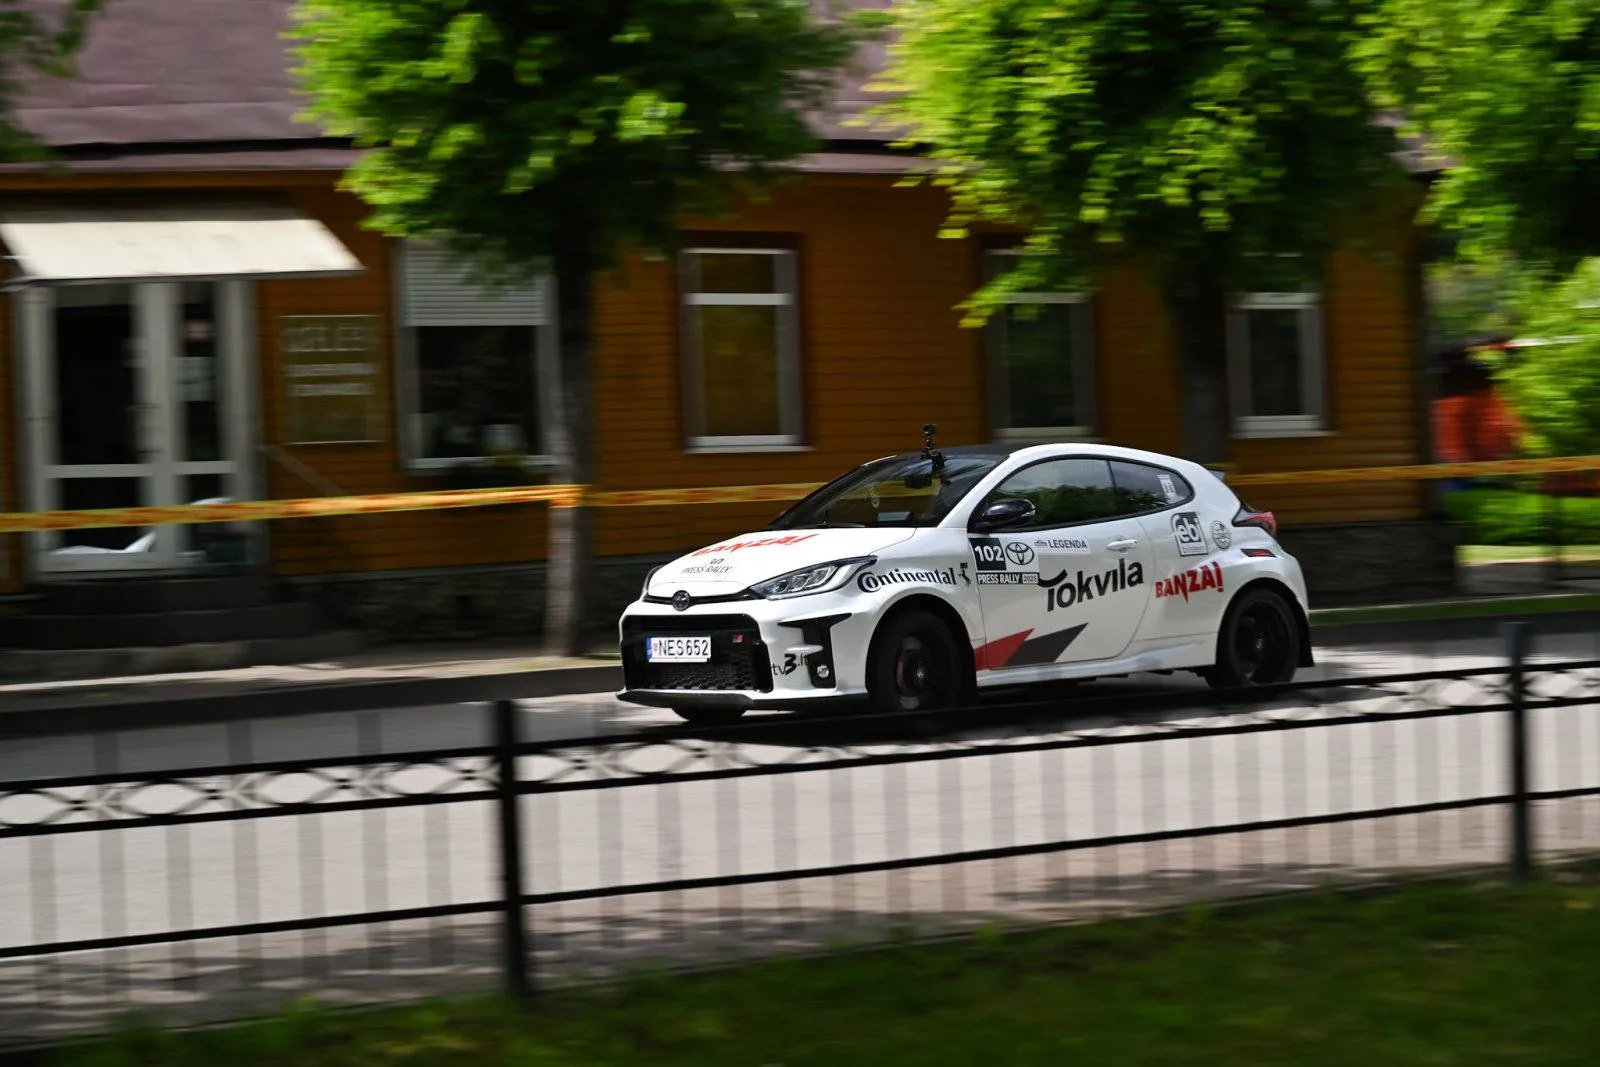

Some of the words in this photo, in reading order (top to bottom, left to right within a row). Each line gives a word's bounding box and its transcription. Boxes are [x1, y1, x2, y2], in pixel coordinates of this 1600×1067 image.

[1048, 539, 1088, 549] LEGENDA
[974, 545, 1005, 562] 102
[857, 567, 958, 593] Continental
[977, 573, 999, 584] PRESS
[999, 573, 1020, 584] RALLY
[1037, 557, 1144, 613] Tokvila
